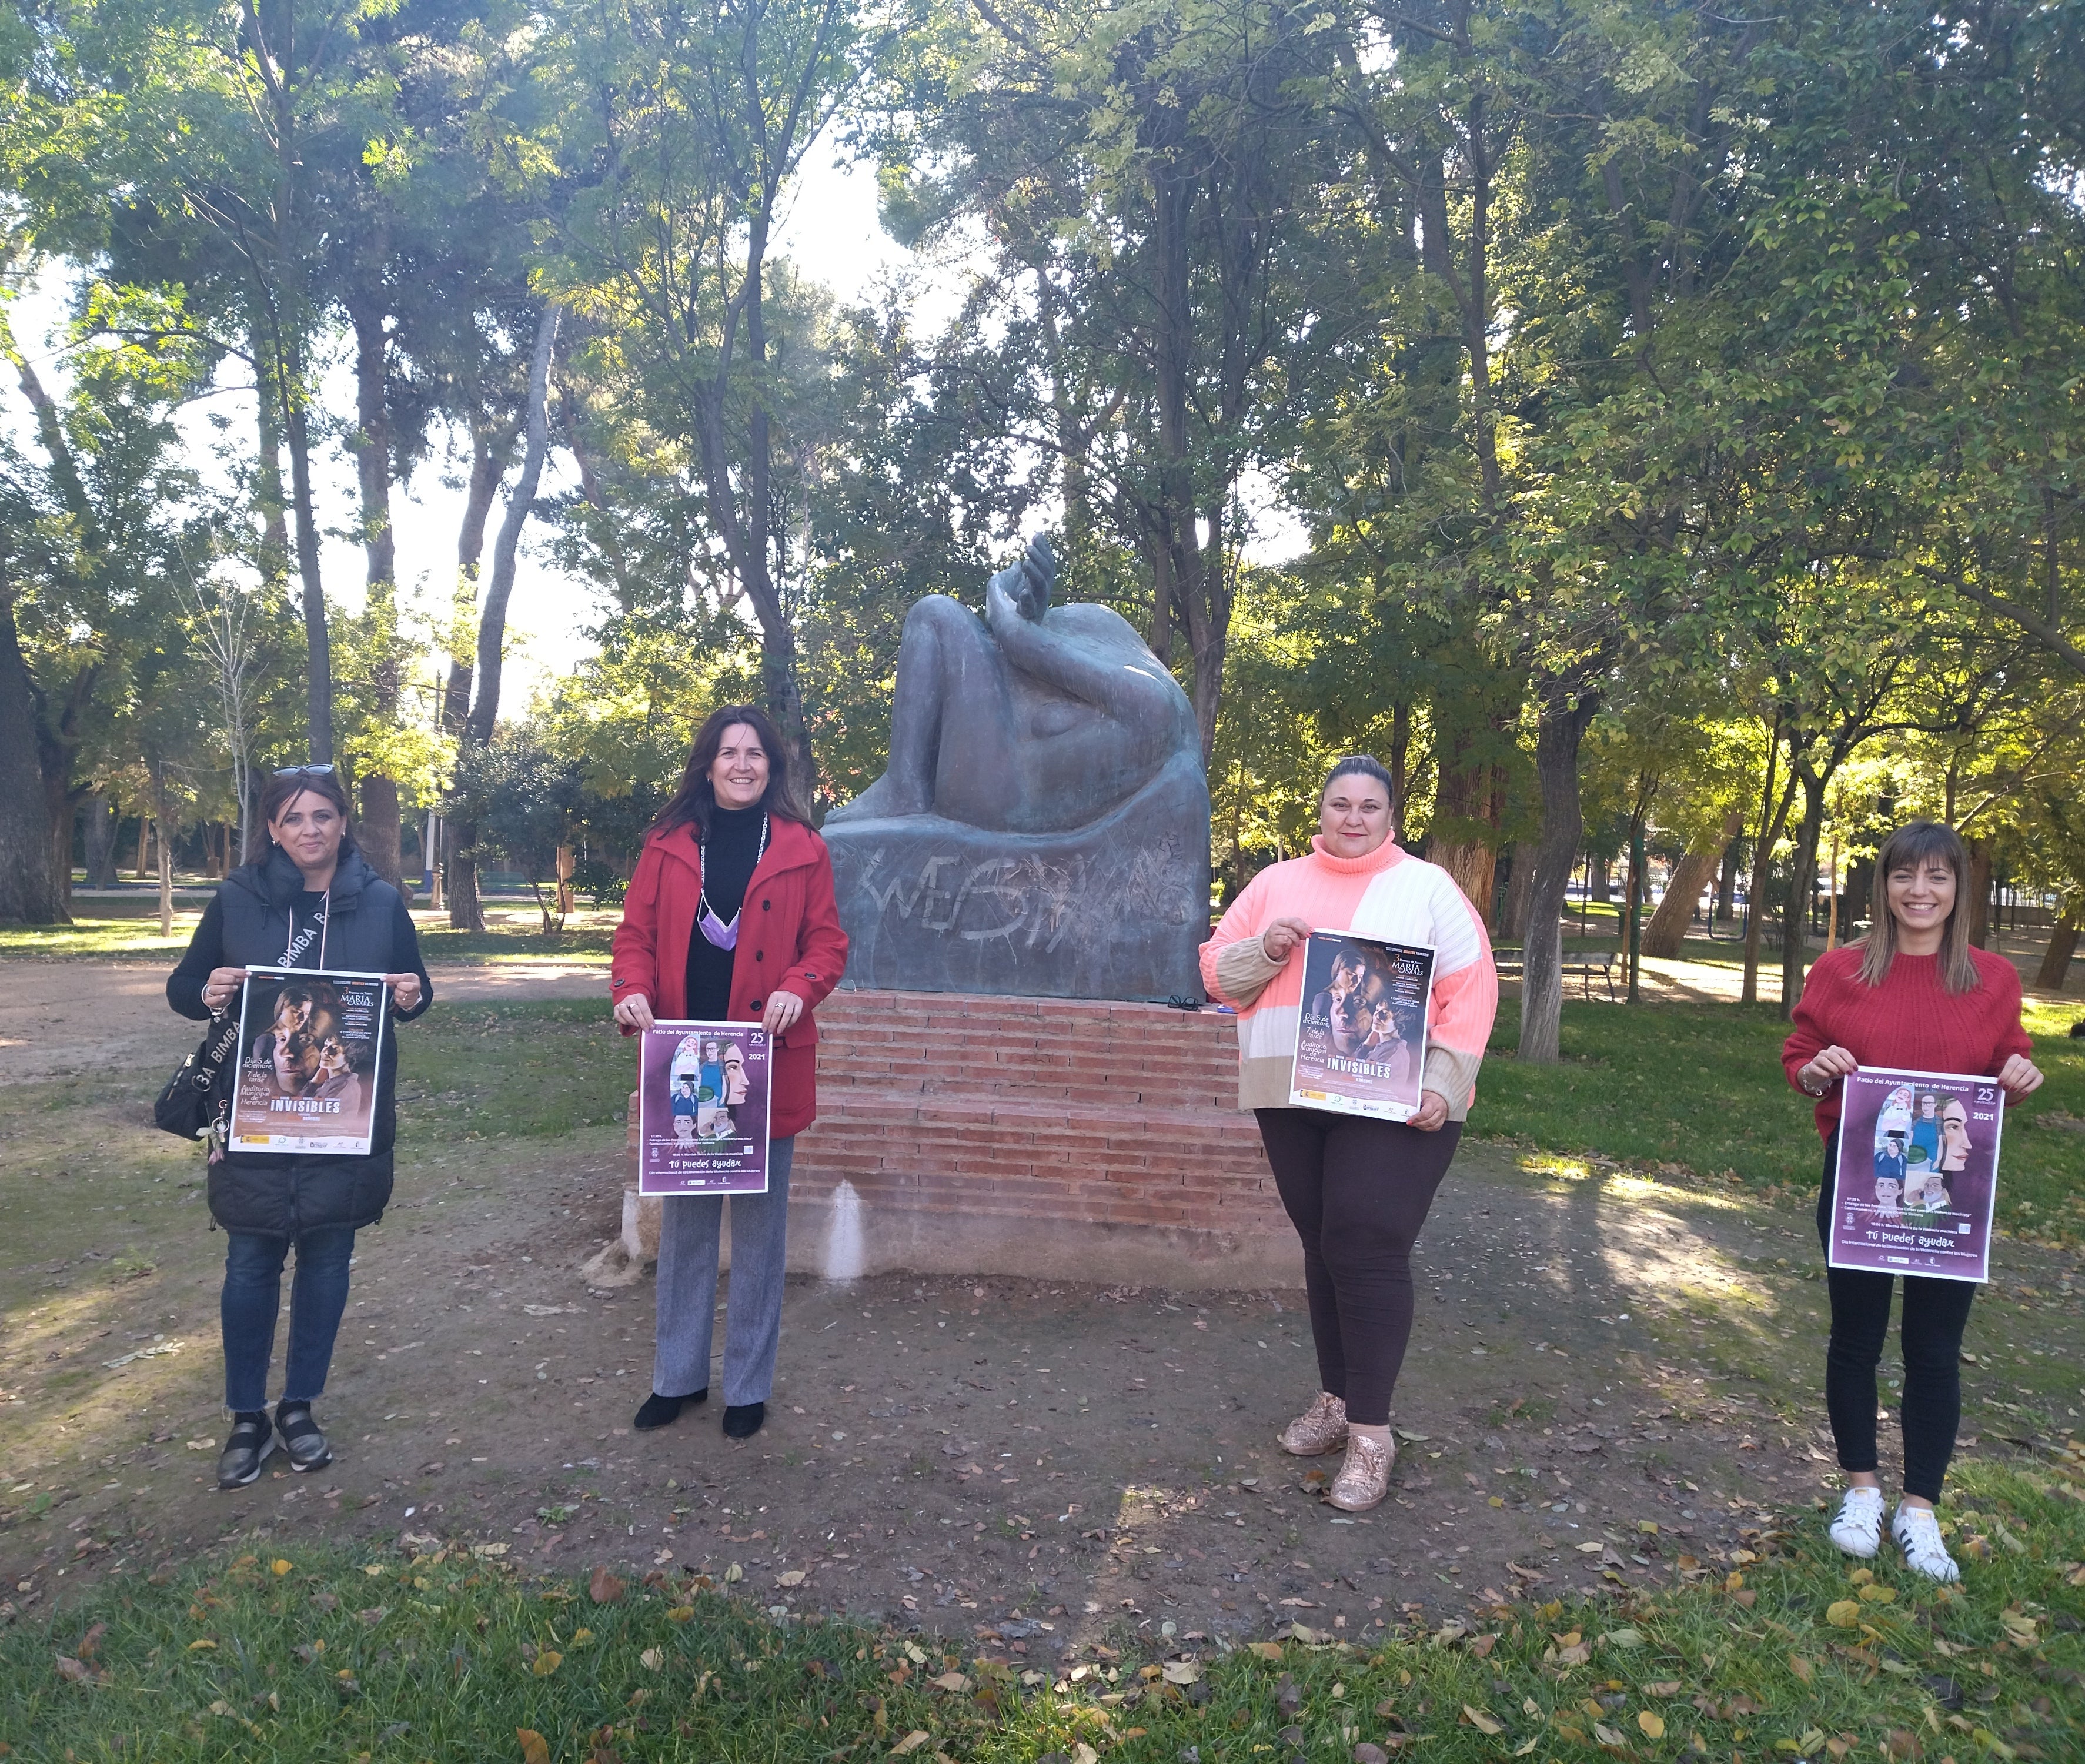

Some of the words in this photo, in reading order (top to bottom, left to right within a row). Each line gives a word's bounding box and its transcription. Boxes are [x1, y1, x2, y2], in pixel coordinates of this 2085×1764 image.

[277, 928, 317, 968] BIMBA
[1302, 1019, 1330, 1028] diciembre,
[210, 1021, 240, 1064] BIMBA
[750, 1032, 764, 1044] 25
[1300, 1044, 1327, 1054] Municipal
[1301, 1040, 1326, 1049] Auditorio
[1301, 1053, 1325, 1063] Herencia
[242, 1062, 273, 1070] diciembre,
[1885, 1079, 1929, 1088] Ayuntamiento
[240, 1088, 270, 1098] Municipal
[1977, 1088, 1994, 1101] 25
[1973, 1112, 1994, 1121] 2021
[682, 1159, 709, 1170] puedes
[711, 1159, 741, 1169] ayudar
[1882, 1232, 1915, 1245] puedes
[1919, 1236, 1955, 1247] ayudar
